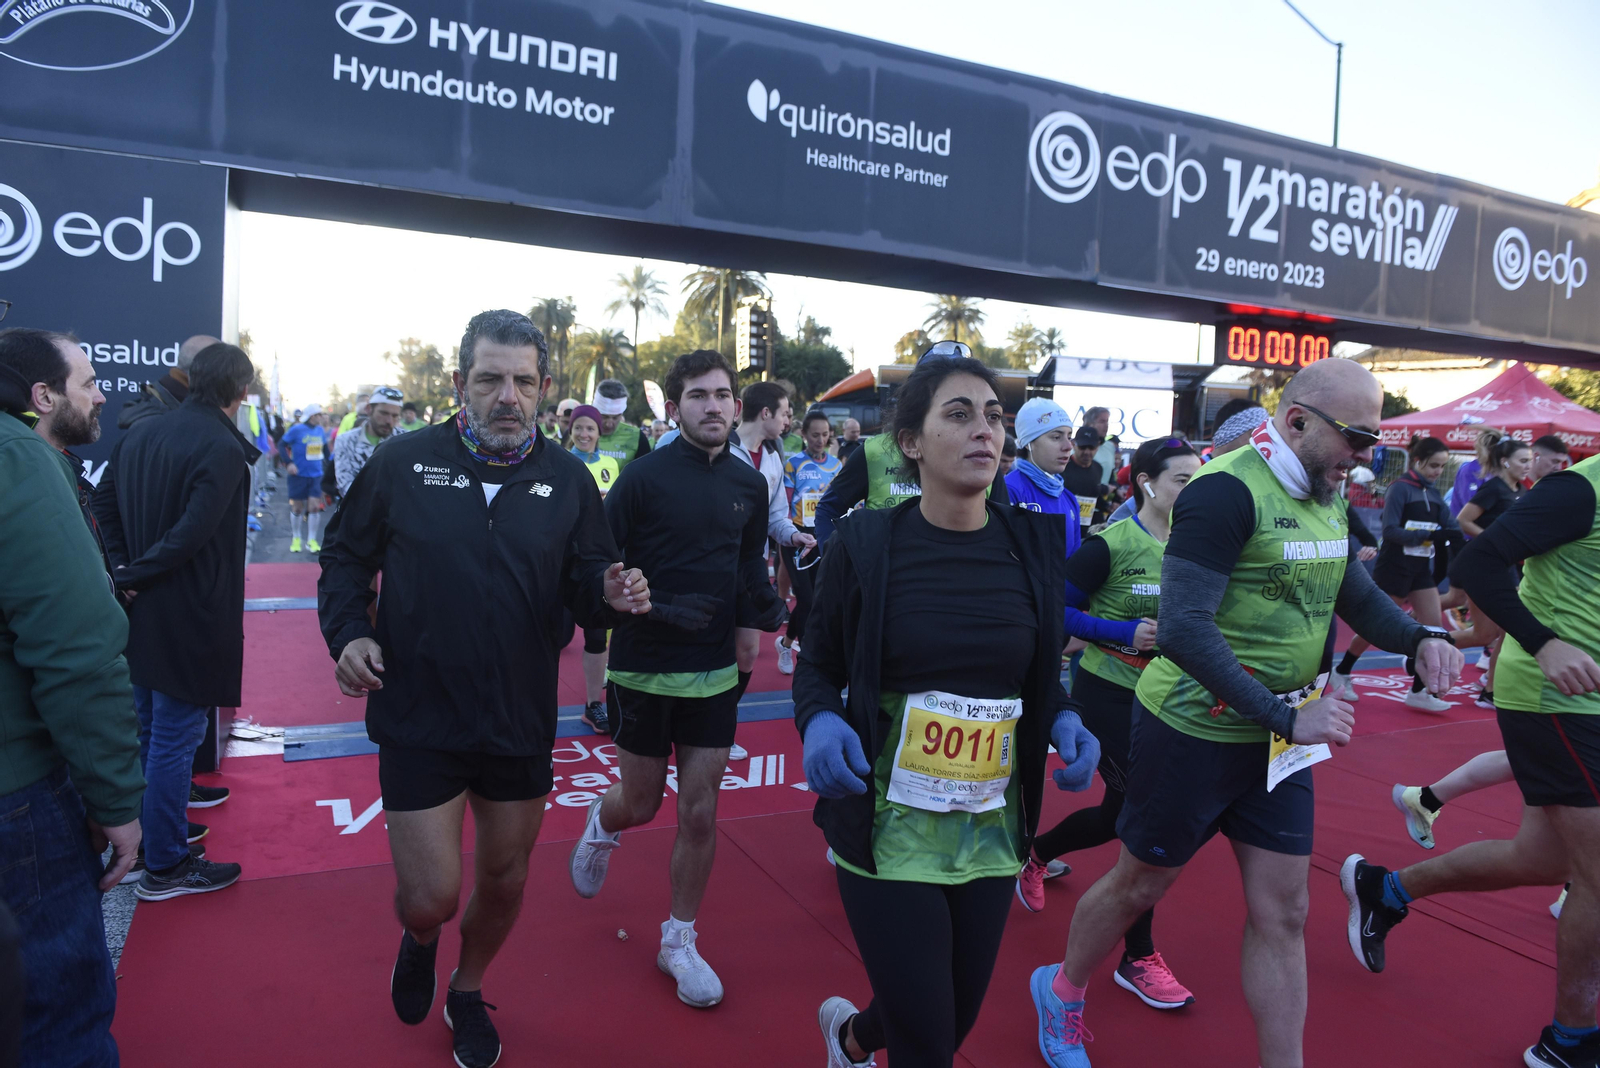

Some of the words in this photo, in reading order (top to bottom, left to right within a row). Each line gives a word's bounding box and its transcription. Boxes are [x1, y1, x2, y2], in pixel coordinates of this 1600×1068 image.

[429, 17, 617, 81] HYUNDAI
[333, 54, 517, 110] Hyundauto
[524, 89, 614, 126] Motor
[778, 102, 951, 157] quirónsalud
[806, 147, 890, 179] Healthcare
[894, 162, 949, 188] Partner
[1106, 133, 1207, 218] edp
[1270, 167, 1424, 233] maratón
[53, 196, 202, 282] edp
[1309, 216, 1429, 272] sevilla
[1195, 247, 1219, 272] 29
[1223, 257, 1280, 283] enero
[1283, 261, 1326, 290] 2023
[1533, 240, 1588, 299] edp
[424, 466, 450, 474] ZURICH
[1274, 517, 1301, 530] HOKA
[1283, 541, 1317, 561] MEDIO
[1121, 567, 1147, 577] HOKA
[1131, 584, 1161, 596] MEDIO
[940, 700, 963, 715] edp
[922, 721, 995, 762] 9011
[905, 761, 931, 774] LAURA
[933, 768, 962, 779] TORRES
[958, 781, 978, 795] edp
